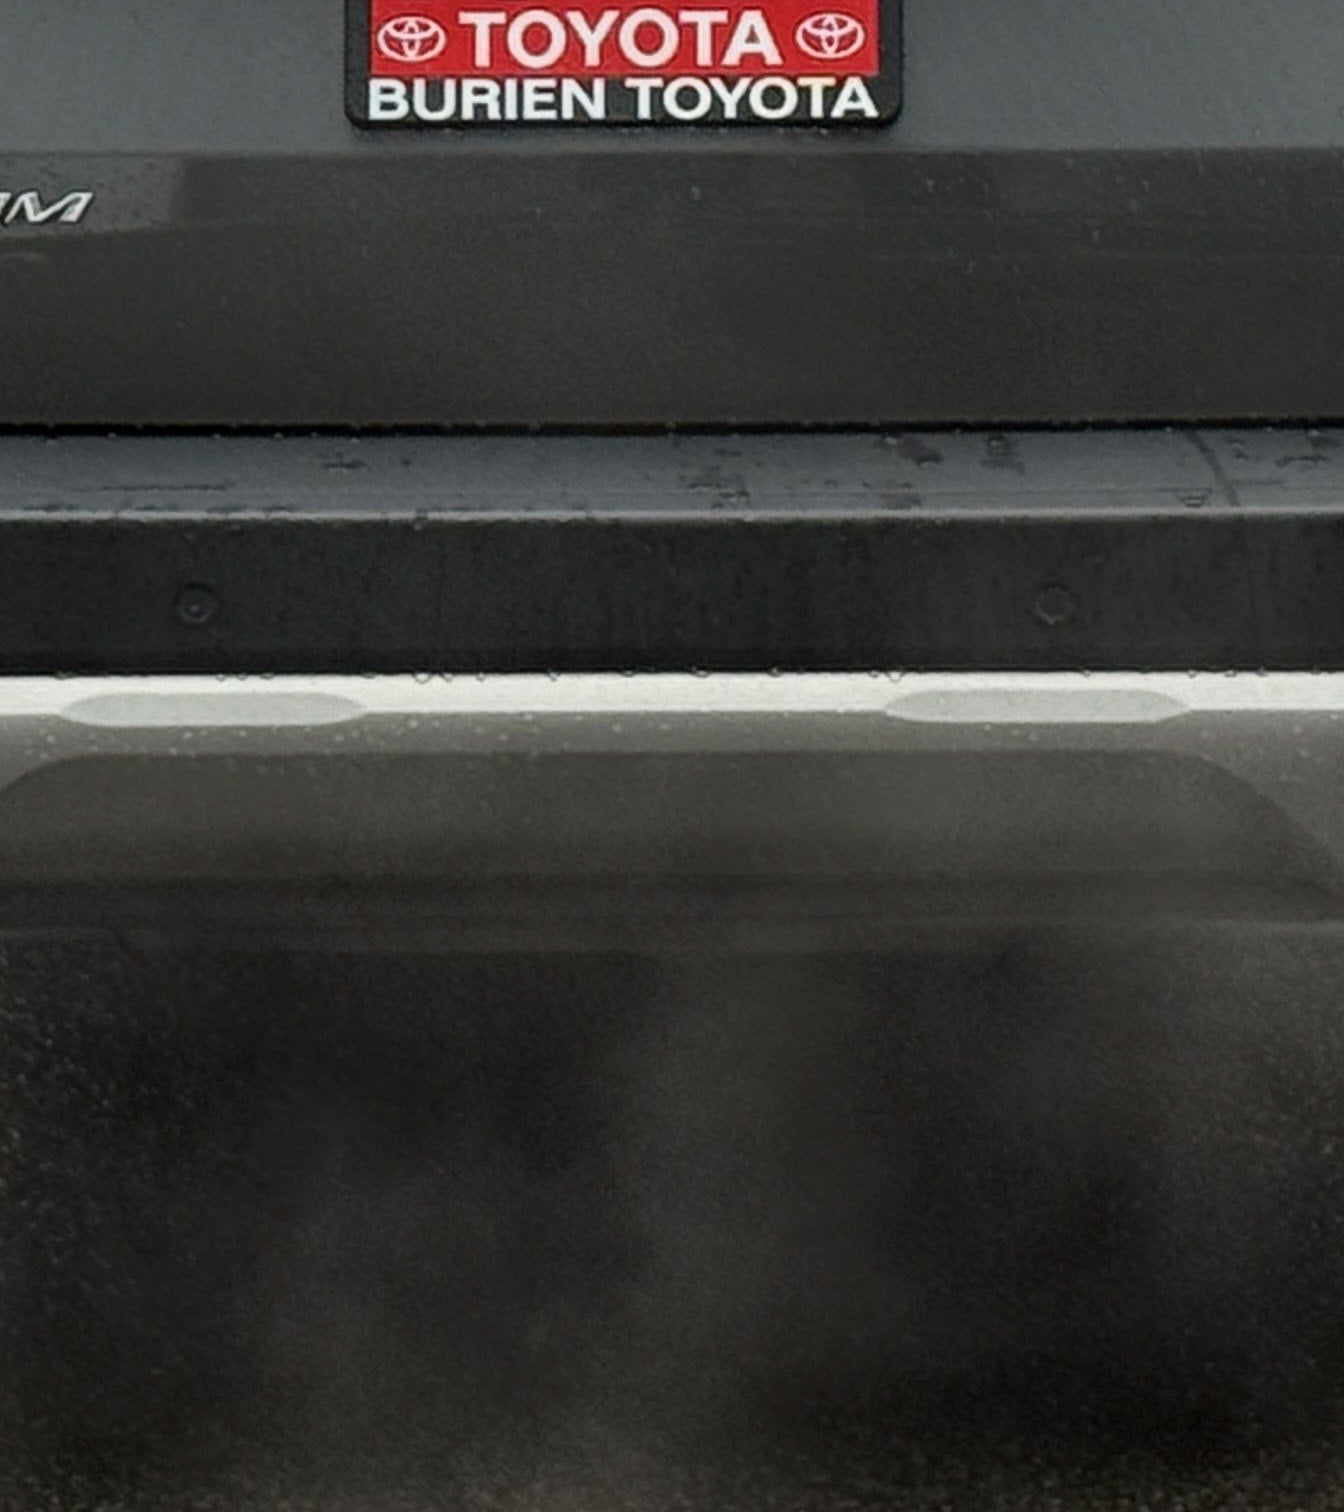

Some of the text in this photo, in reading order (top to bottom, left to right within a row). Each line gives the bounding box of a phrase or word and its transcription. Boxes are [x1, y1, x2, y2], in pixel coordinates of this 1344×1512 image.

[459, 9, 786, 68] TOYOTA
[368, 75, 879, 122] BURIEN TOYOTA
